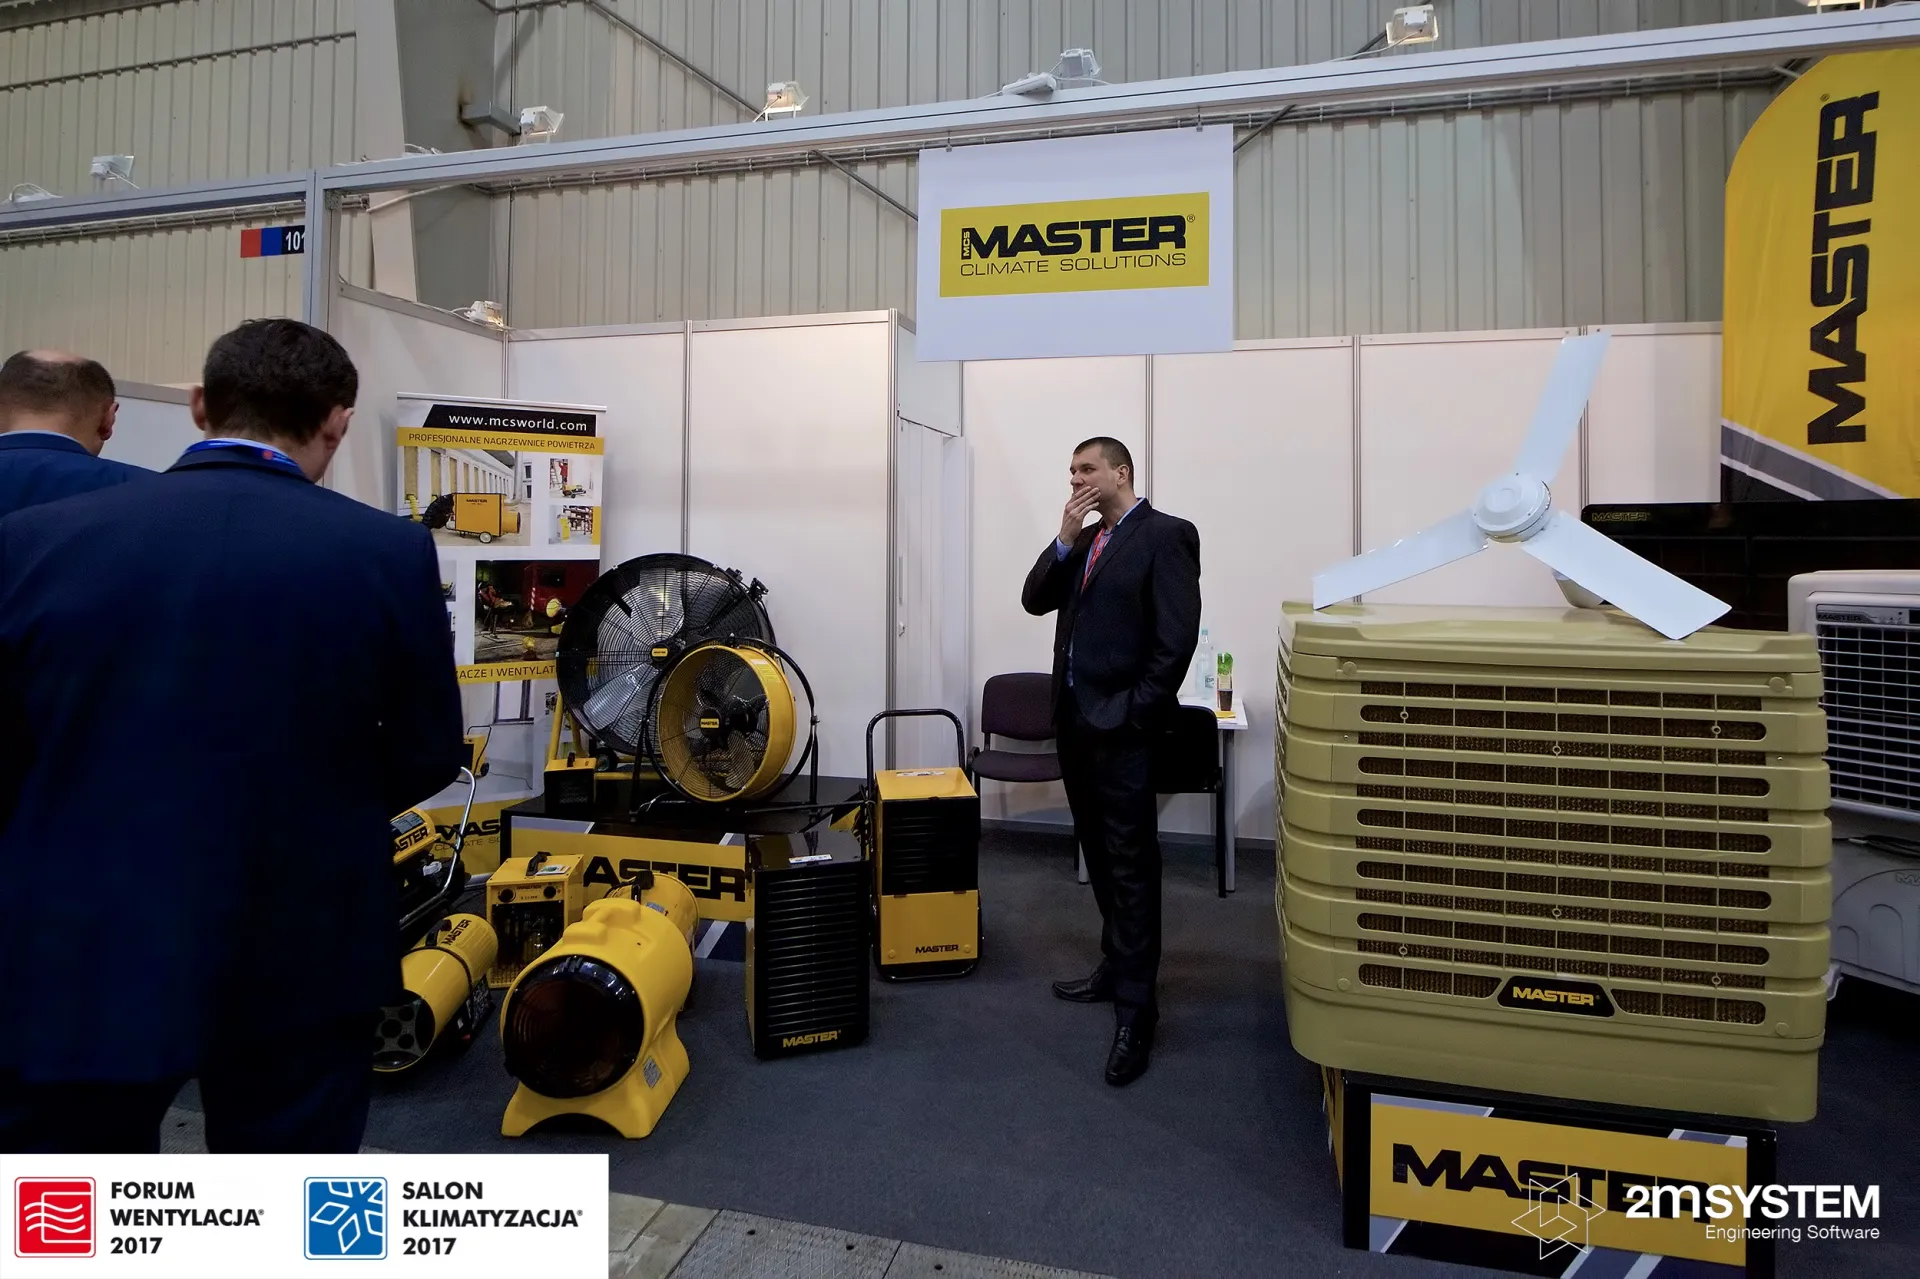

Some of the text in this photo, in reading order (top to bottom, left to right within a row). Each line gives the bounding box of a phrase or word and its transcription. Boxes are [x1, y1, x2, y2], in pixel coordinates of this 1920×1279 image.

[962, 215, 1187, 260] MASTER
[963, 230, 972, 257] MCS
[960, 253, 1187, 276] CLIMATE SOLUTIONS
[1808, 91, 1880, 445] MASTER
[449, 414, 588, 432] www.mcsworld.com
[408, 433, 596, 450] PROFESJONALNE NAGRZEWNICE POWIETRZA
[1591, 512, 1648, 521] MASTER
[457, 668, 488, 679] ACZE
[496, 665, 556, 677] WENTYLAT
[396, 825, 429, 852] ASTER
[435, 818, 500, 841] MAS
[583, 855, 746, 903] ASTER
[441, 918, 473, 946] MASTER
[915, 944, 960, 954] MASTER
[1513, 986, 1594, 1006] MASTER
[782, 1030, 839, 1048] MASTER
